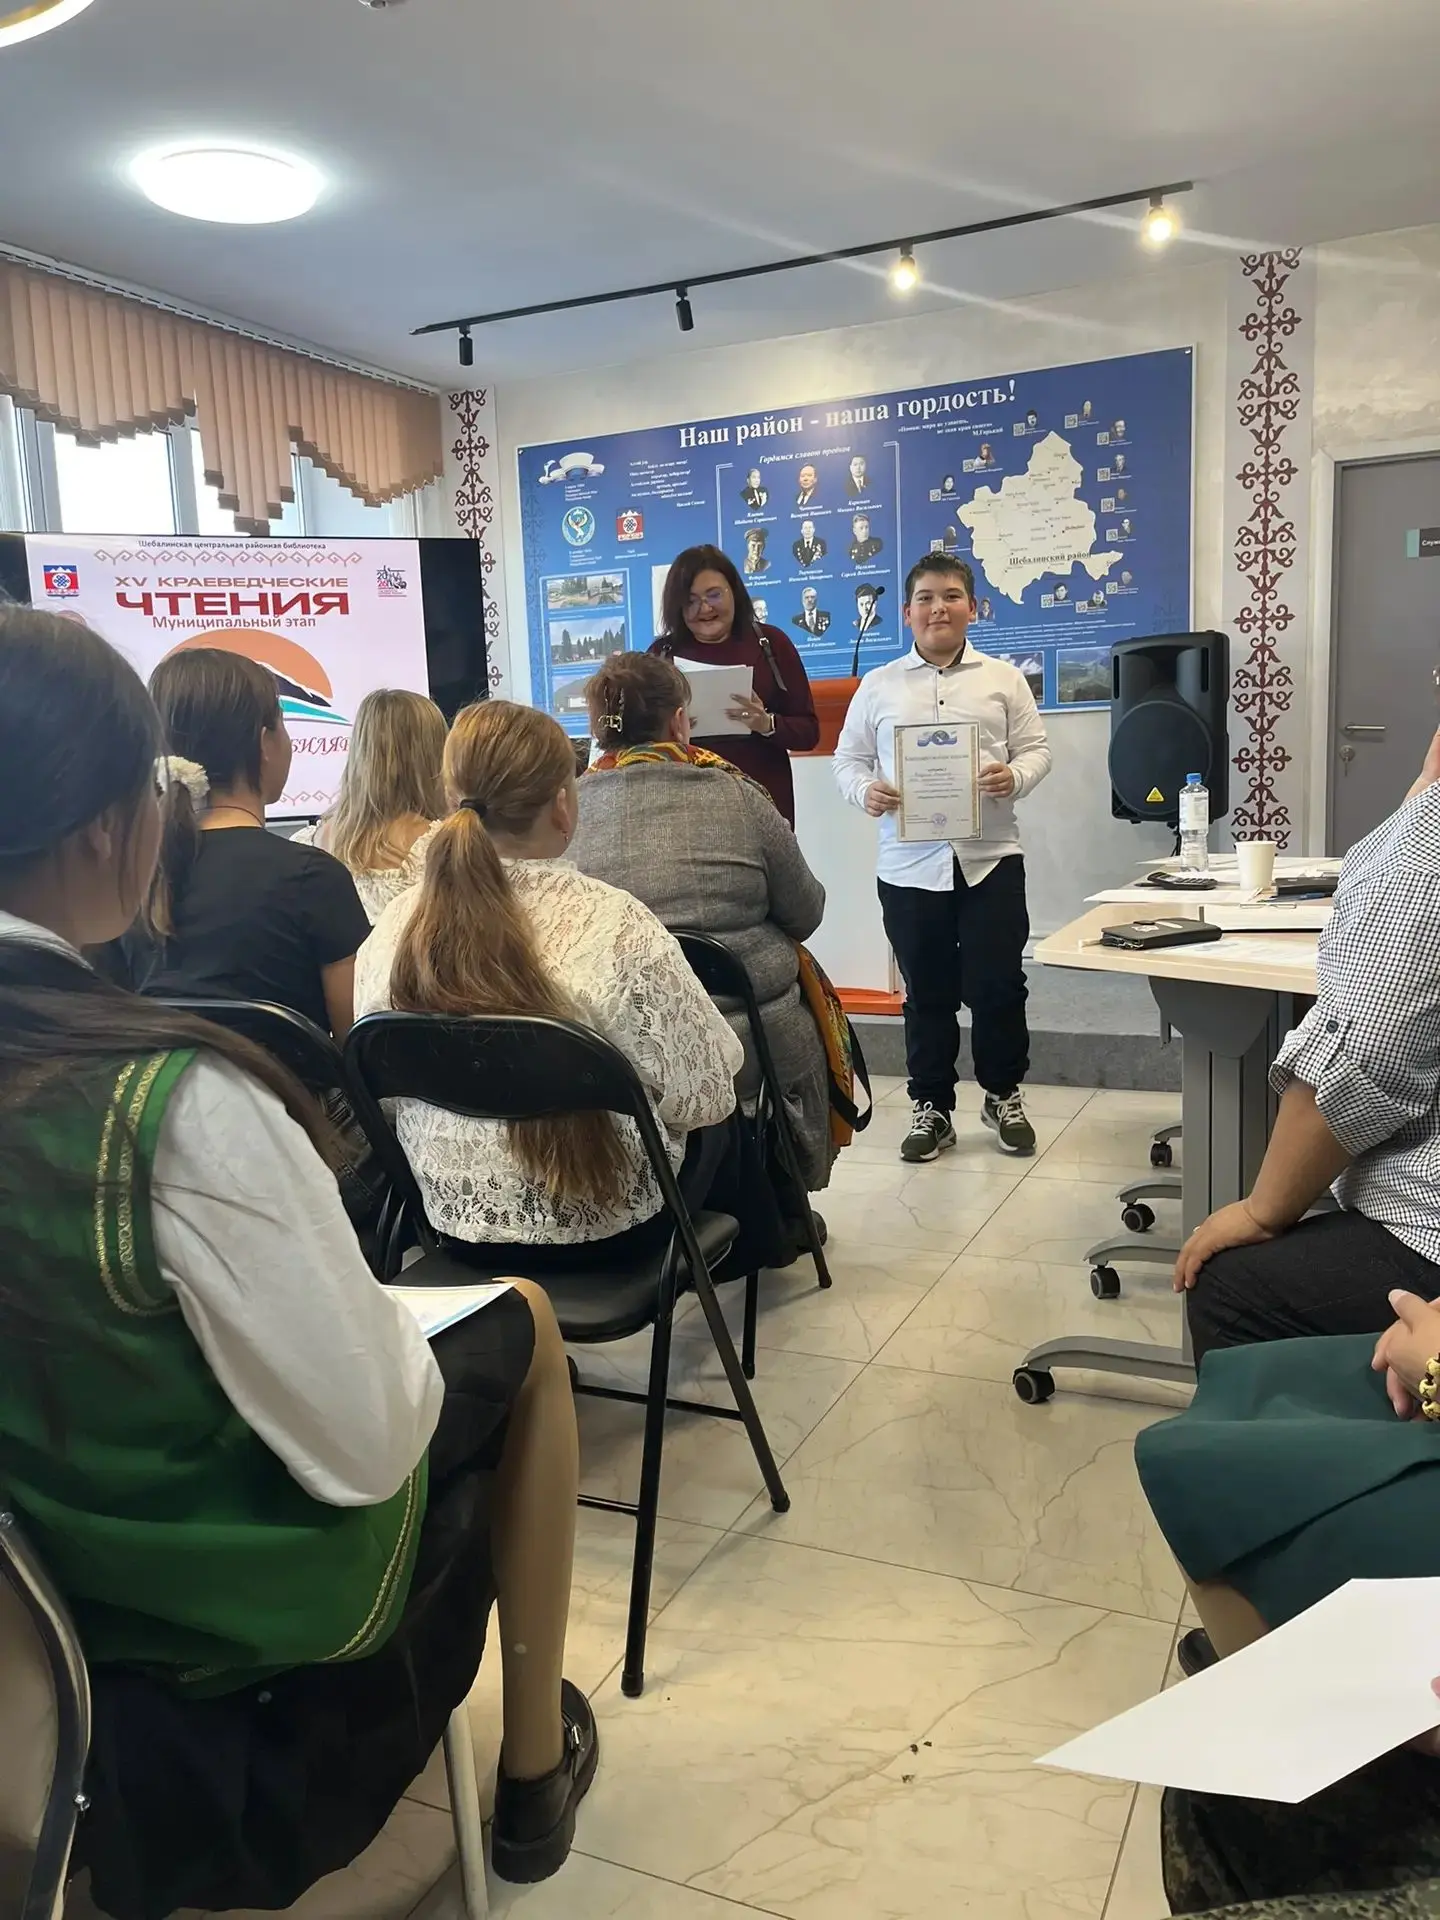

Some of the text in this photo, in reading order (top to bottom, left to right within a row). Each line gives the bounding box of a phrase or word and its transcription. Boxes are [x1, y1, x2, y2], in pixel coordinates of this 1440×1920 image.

[679, 427, 729, 448] Наш
[735, 416, 803, 445] район
[825, 403, 889, 428] наша
[897, 378, 1016, 420] гордость!
[759, 454, 794, 464] Гордимся
[138, 540, 193, 548] Шебалинская
[194, 541, 243, 549] центральная
[245, 541, 282, 550] районная
[1009, 552, 1091, 565] Шебалинский район
[114, 576, 348, 588] XV КРАЕВЕДЧЕСКИЕ
[116, 592, 349, 616] ЧТЕНИЯ
[152, 614, 316, 631] Муниципальный этап
